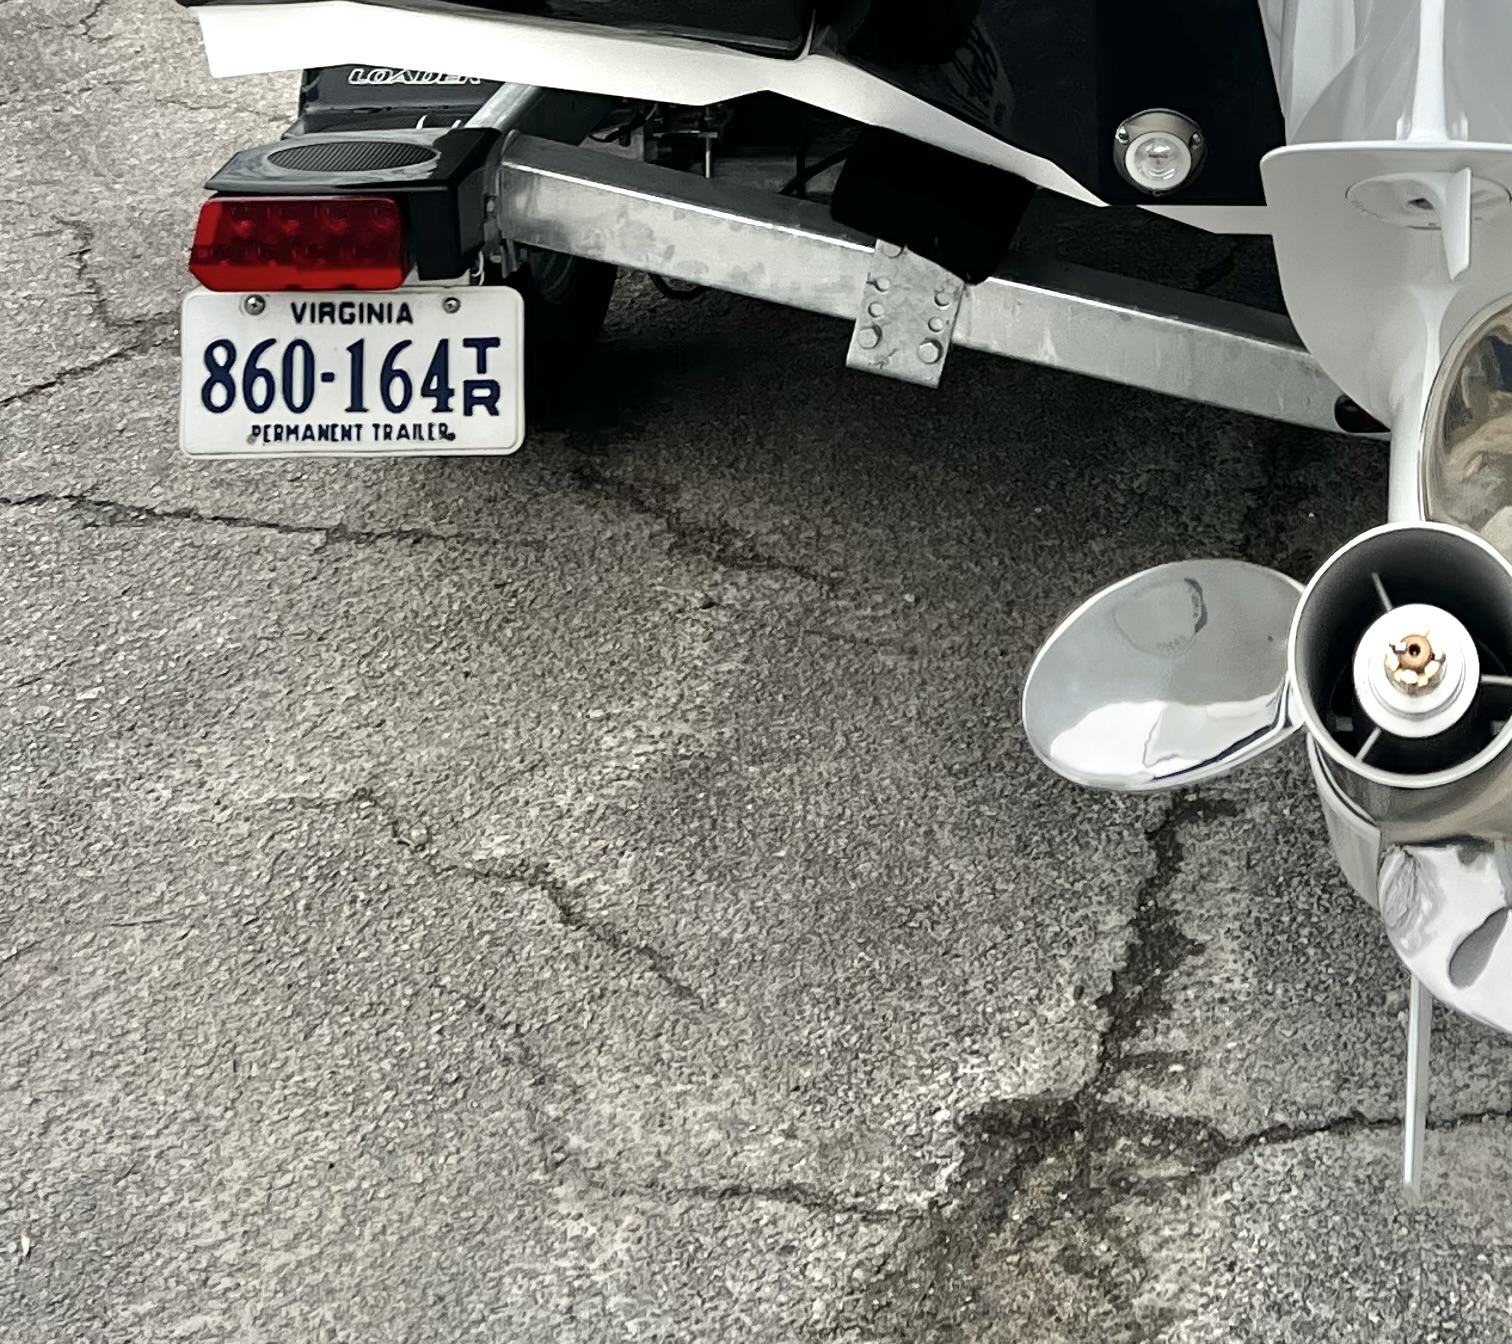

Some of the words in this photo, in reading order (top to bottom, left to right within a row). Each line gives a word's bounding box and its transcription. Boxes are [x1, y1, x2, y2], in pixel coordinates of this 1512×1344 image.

[290, 301, 413, 325] VIRGINIA
[201, 338, 455, 413] 860-164
[251, 424, 363, 442] PERMANENT
[372, 423, 455, 442] TRAILER
